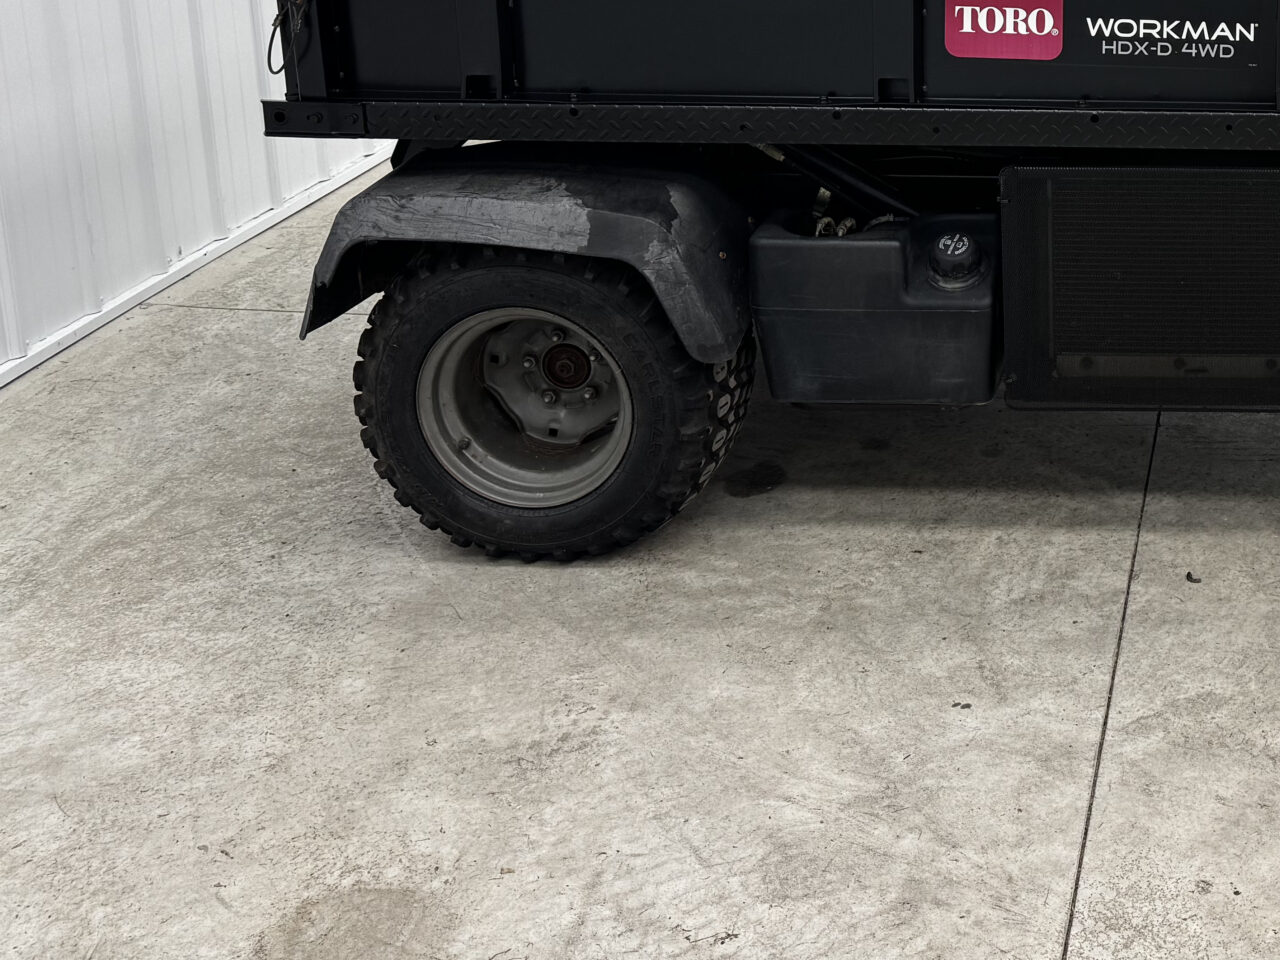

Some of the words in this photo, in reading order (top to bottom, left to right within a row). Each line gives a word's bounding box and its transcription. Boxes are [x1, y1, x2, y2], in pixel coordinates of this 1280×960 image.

[1086, 17, 1255, 42] WORKMAN
[1102, 40, 1172, 56] HDX-D
[1181, 42, 1235, 58] 4WD
